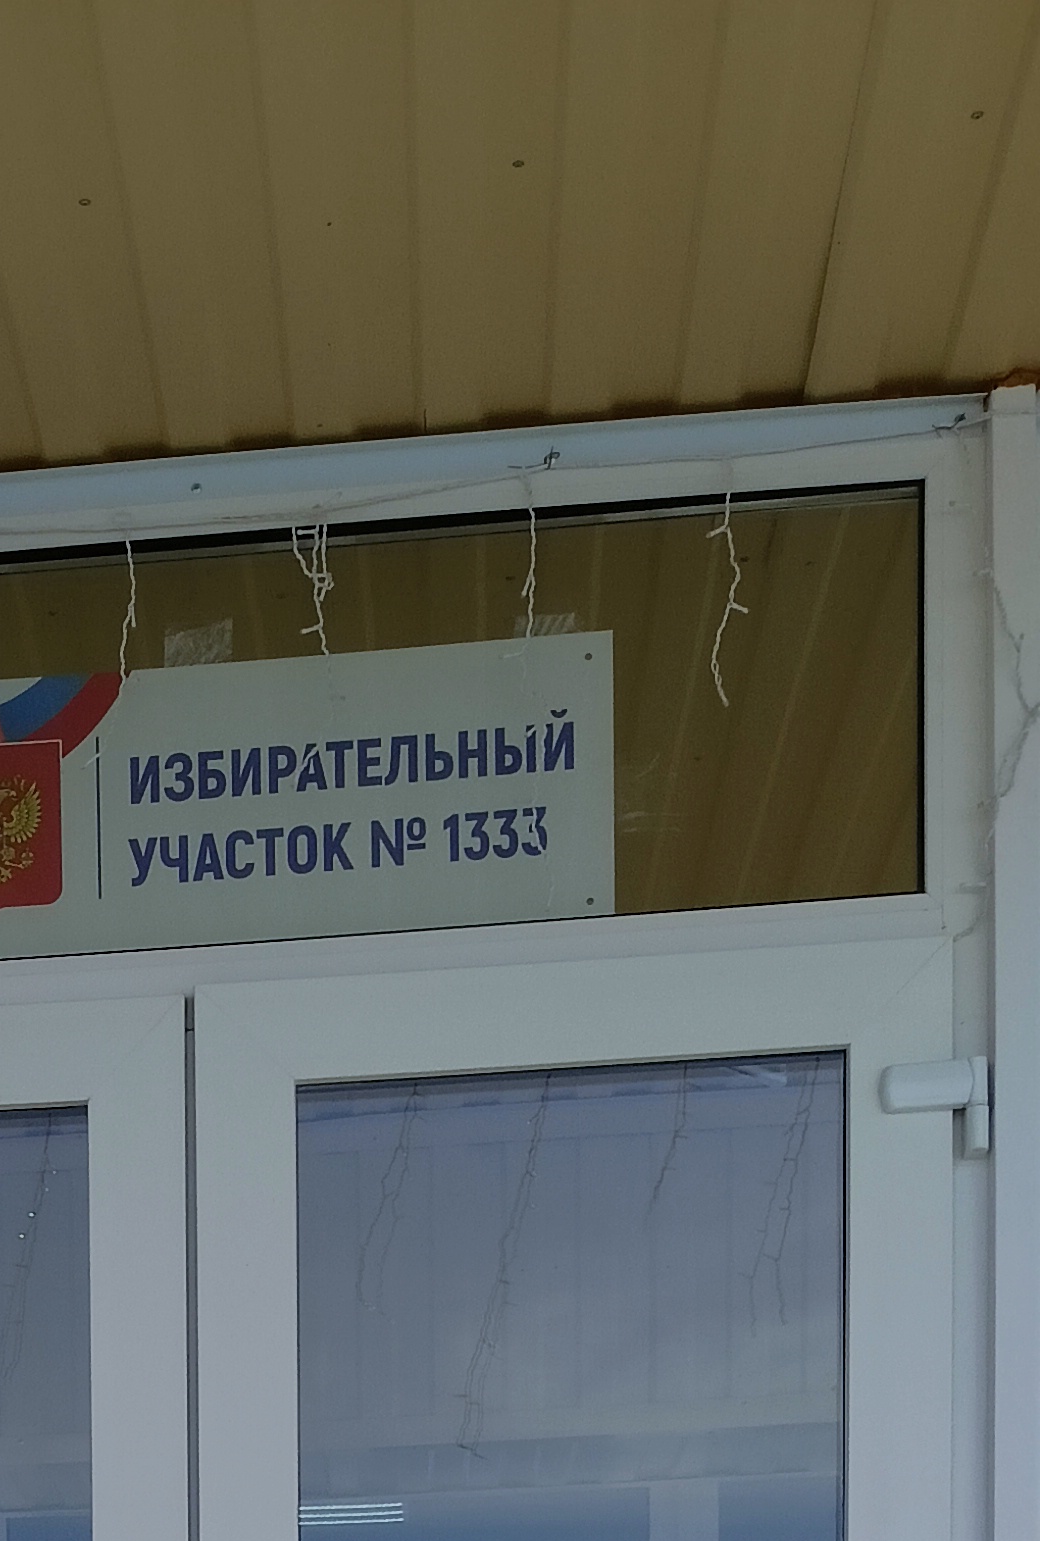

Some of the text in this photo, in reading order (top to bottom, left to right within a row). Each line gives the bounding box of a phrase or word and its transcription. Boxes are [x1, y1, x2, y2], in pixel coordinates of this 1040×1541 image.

[128, 708, 576, 805] ИЗБИРАТЕЛЬНЫЙ
[128, 806, 548, 888] УЧАСТОК № 1333
